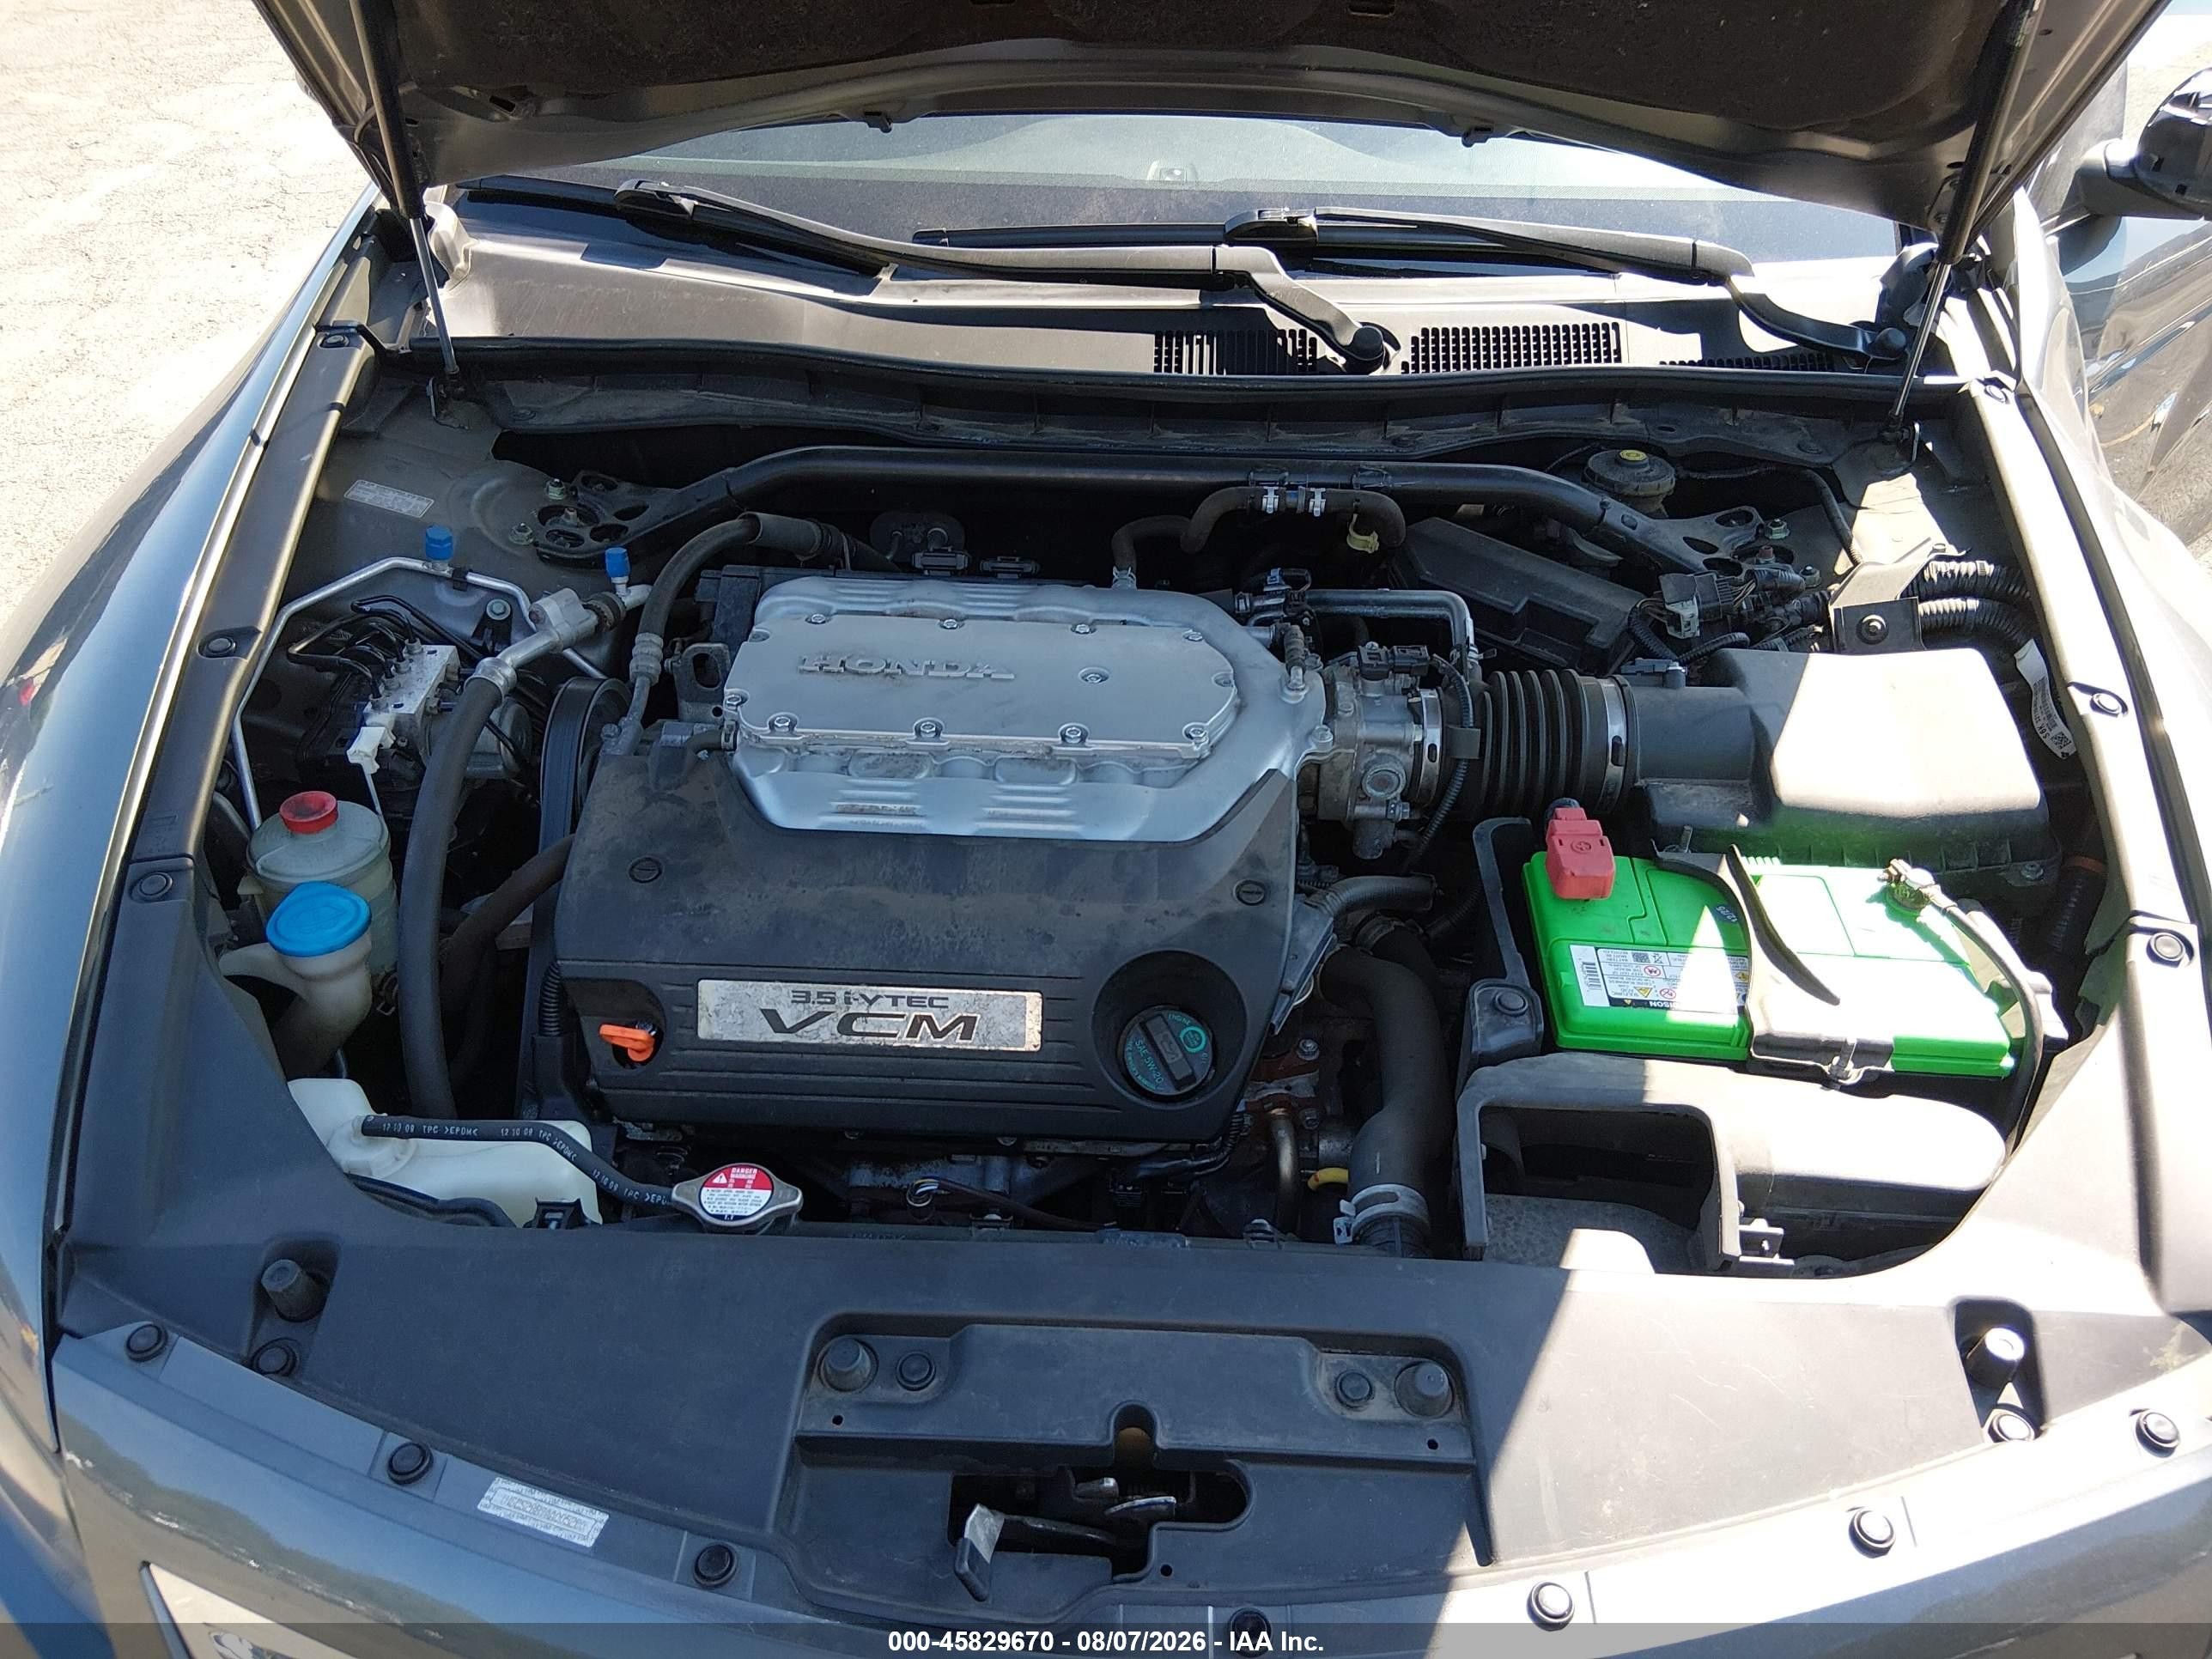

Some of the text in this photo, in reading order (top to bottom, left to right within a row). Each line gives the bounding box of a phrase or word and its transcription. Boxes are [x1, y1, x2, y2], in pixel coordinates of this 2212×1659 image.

[797, 654, 1015, 679] HONDA
[791, 990, 949, 1009] 3.5 i-VTEC
[760, 1008, 979, 1042] VCM
[1135, 1039, 1164, 1084] SAE 5W-20
[501, 1128, 509, 1137] 12
